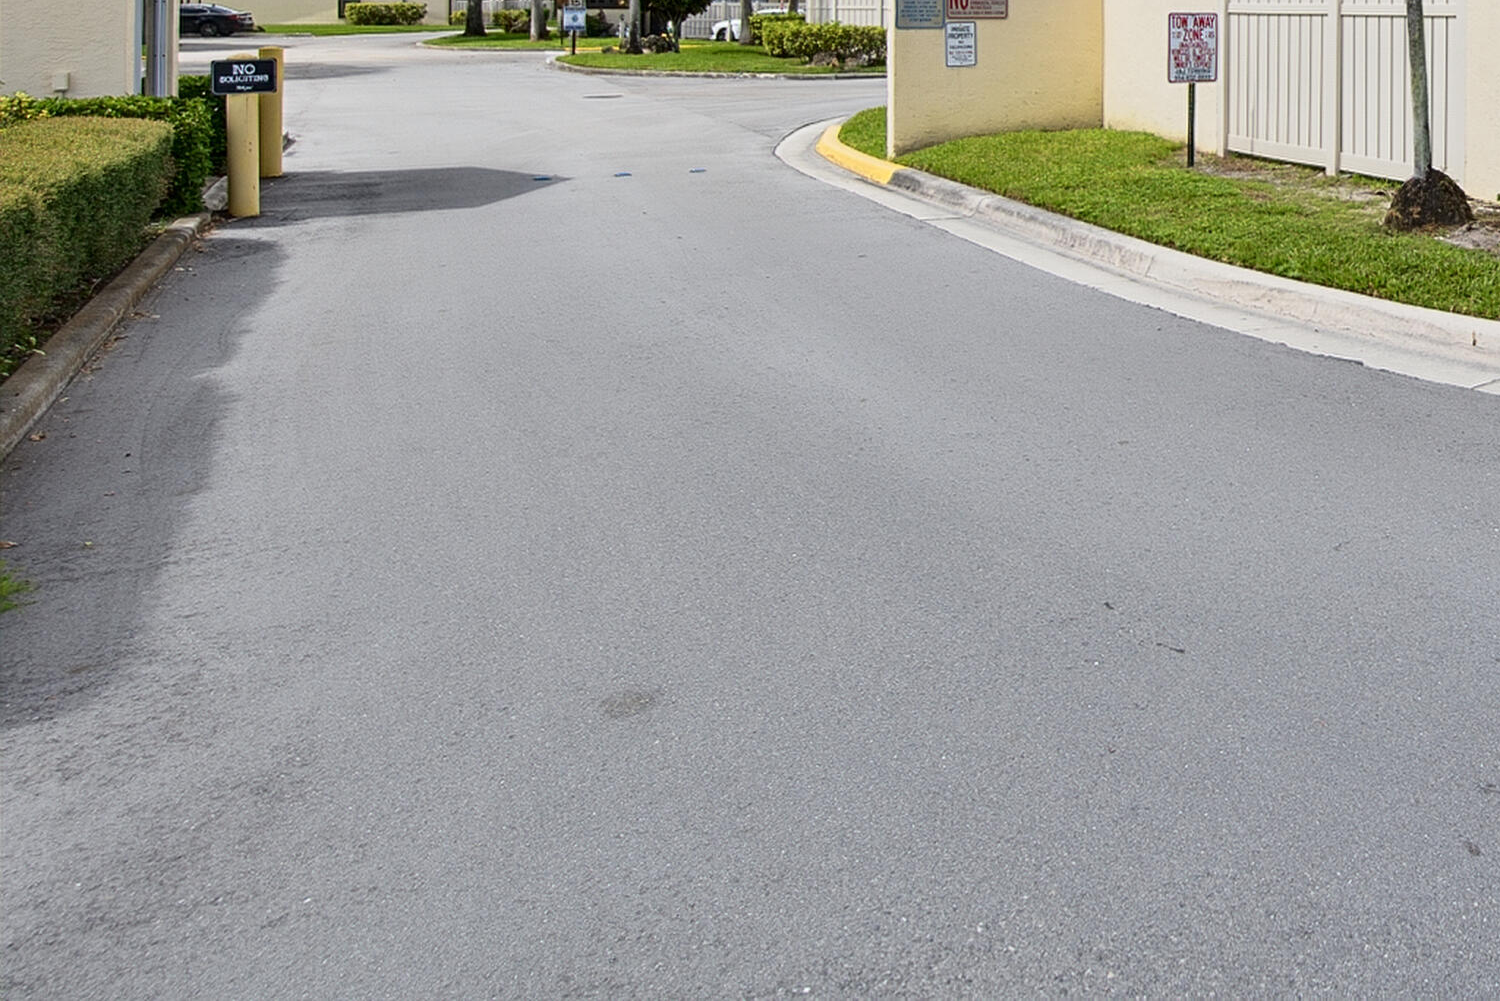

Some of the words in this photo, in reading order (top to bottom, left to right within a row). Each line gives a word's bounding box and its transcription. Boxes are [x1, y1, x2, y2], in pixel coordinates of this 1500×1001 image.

[1172, 16, 1188, 29] TOW
[1193, 16, 1215, 29] AWAY
[1183, 28, 1204, 42] ZONE
[232, 63, 256, 75] NO
[219, 74, 269, 84] SOLICITING
